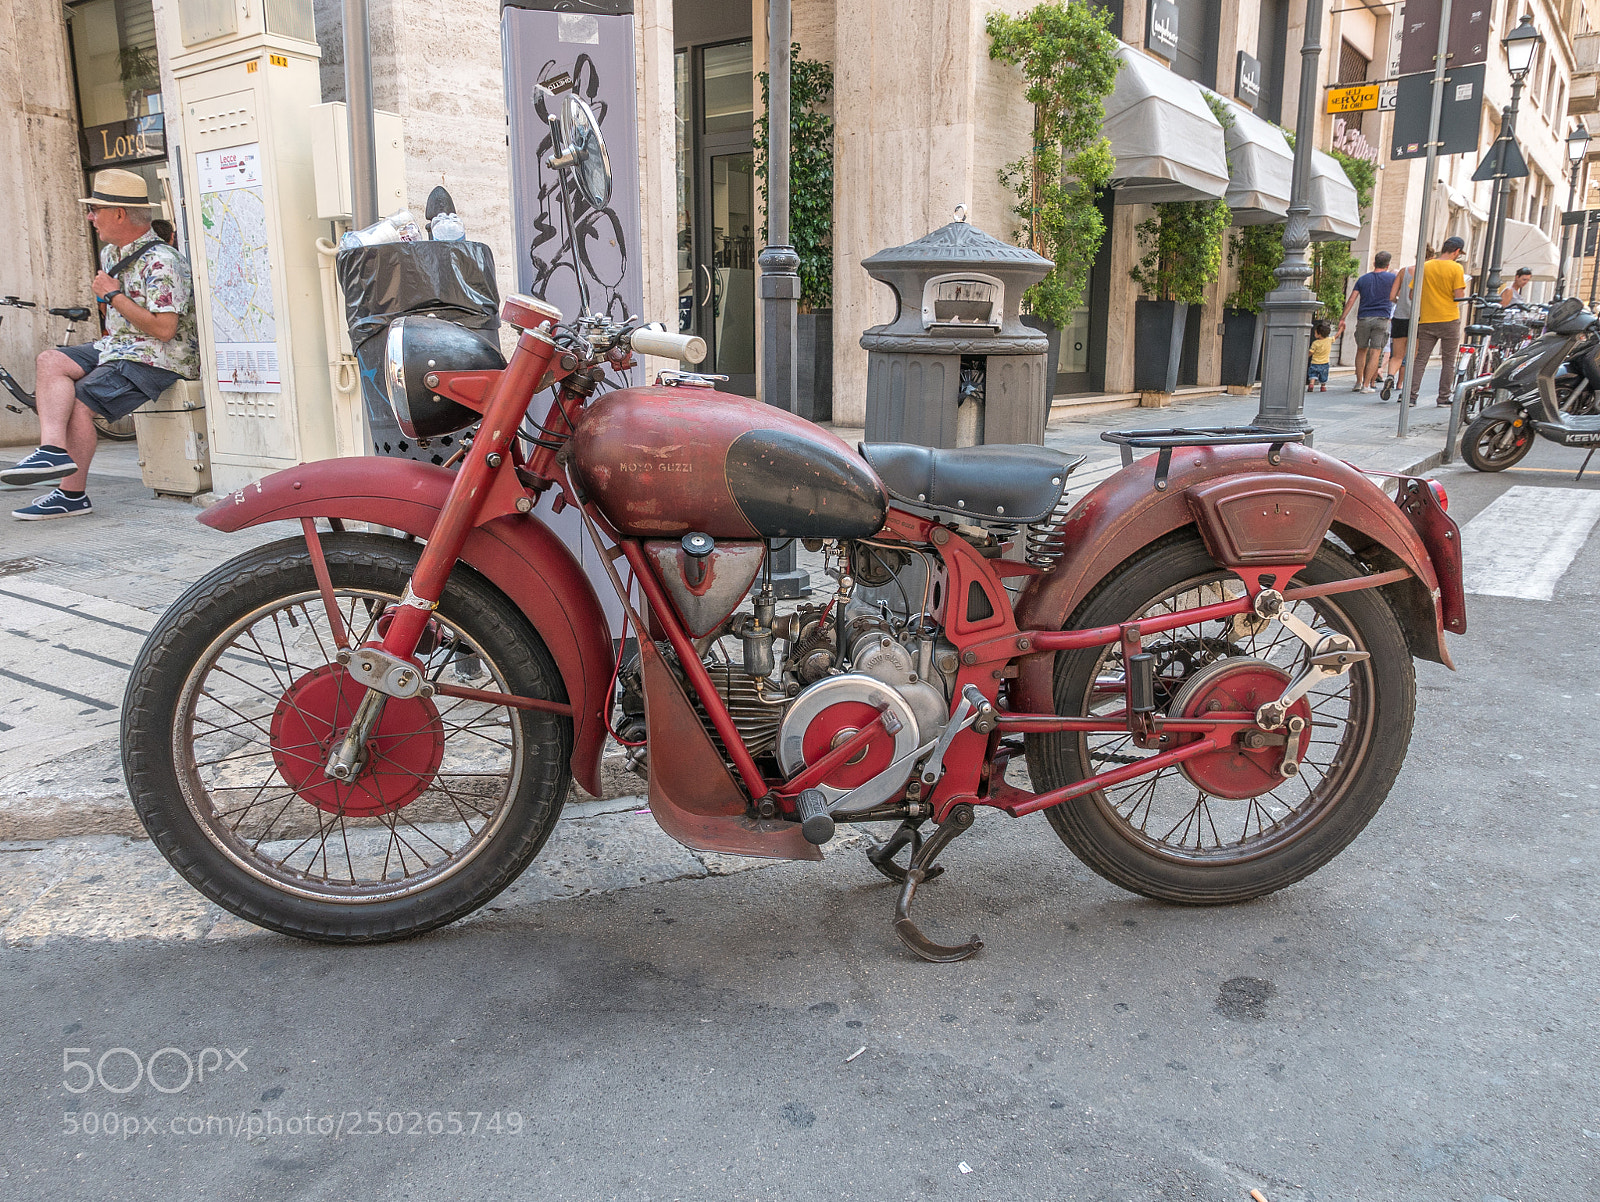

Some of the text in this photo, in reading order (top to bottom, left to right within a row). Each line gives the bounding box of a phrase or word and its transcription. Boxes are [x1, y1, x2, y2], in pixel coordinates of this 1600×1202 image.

[1331, 94, 1375, 105] SERVICE
[100, 121, 147, 160] Lord
[219, 154, 237, 164] Lecce
[659, 463, 692, 472] GUZZI
